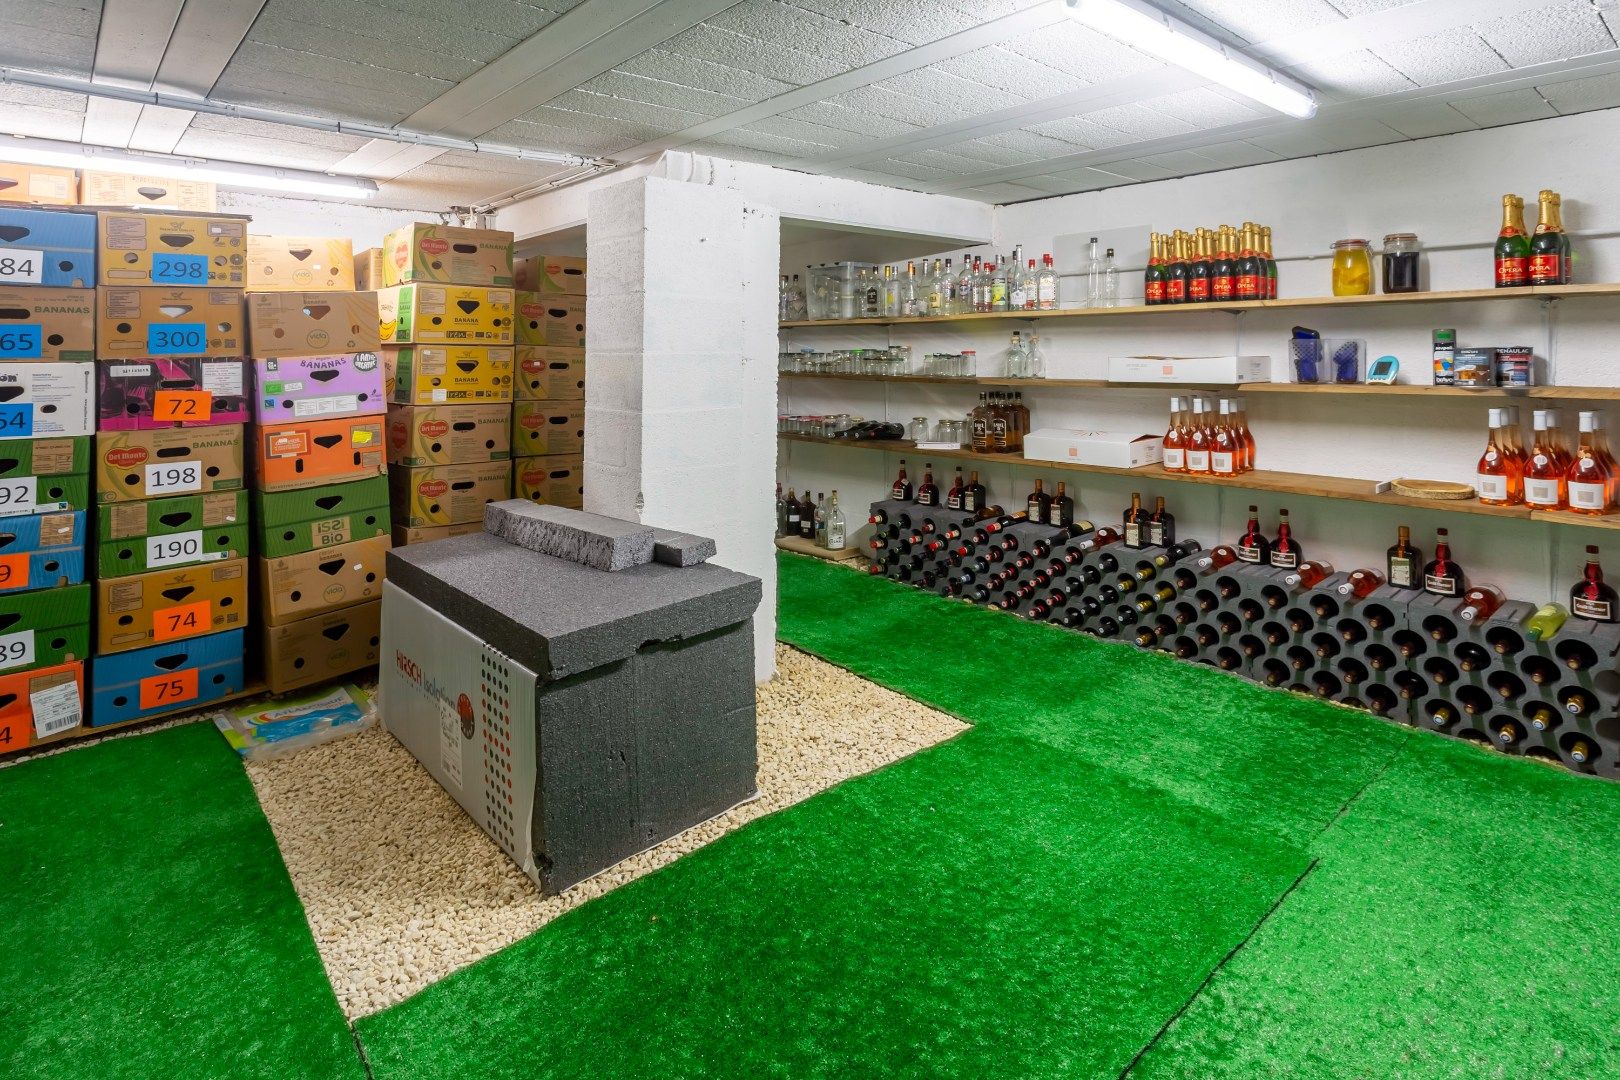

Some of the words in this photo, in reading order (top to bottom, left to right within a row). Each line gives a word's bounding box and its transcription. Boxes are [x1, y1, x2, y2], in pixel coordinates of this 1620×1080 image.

[0, 257, 34, 277] 84
[158, 260, 203, 278] 298
[34, 305, 90, 314] BANANAS
[0, 333, 33, 351] 65
[155, 331, 200, 348] 300
[299, 357, 347, 369] BANANAS
[168, 399, 196, 415] 72
[192, 439, 240, 449] BANANAS
[108, 453, 121, 461] Del
[121, 451, 146, 460] Monte
[151, 467, 196, 487] 198
[153, 538, 198, 561] 190
[326, 585, 343, 596] vida
[167, 611, 197, 632] 74
[396, 649, 422, 687] HIRSCH
[155, 679, 184, 701] 75
